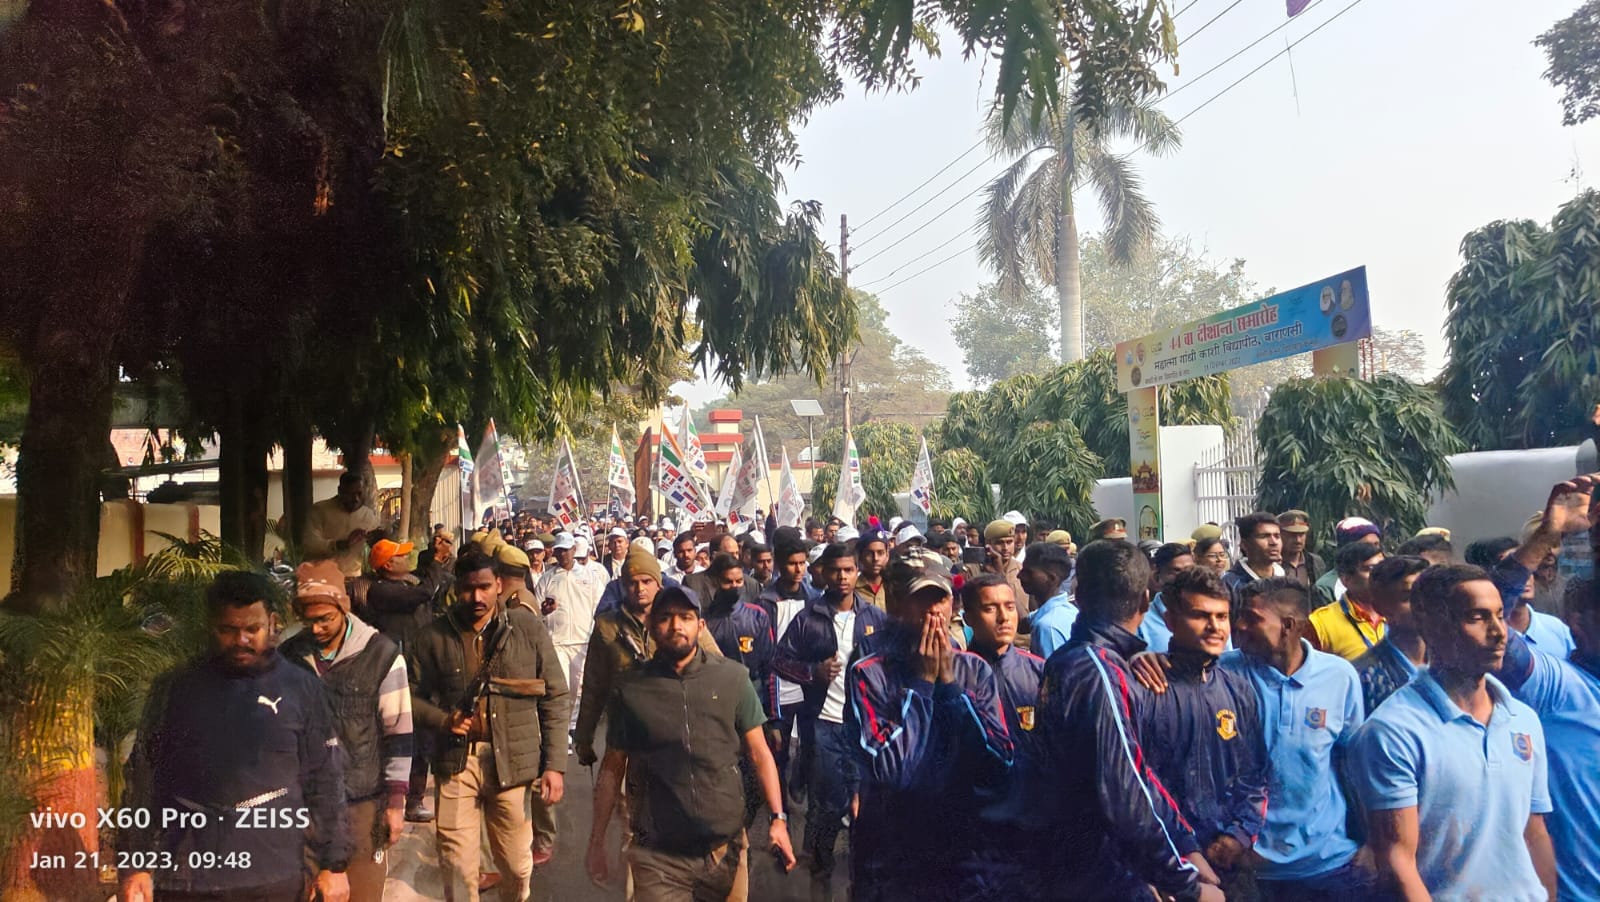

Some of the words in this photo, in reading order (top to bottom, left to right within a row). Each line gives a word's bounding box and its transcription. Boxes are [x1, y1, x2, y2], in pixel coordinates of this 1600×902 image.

[1237, 304, 1278, 330] समारोह
[1154, 356, 1177, 370] महात्मा
[1199, 343, 1220, 359] काशी
[1264, 321, 1303, 342] वाराणसी
